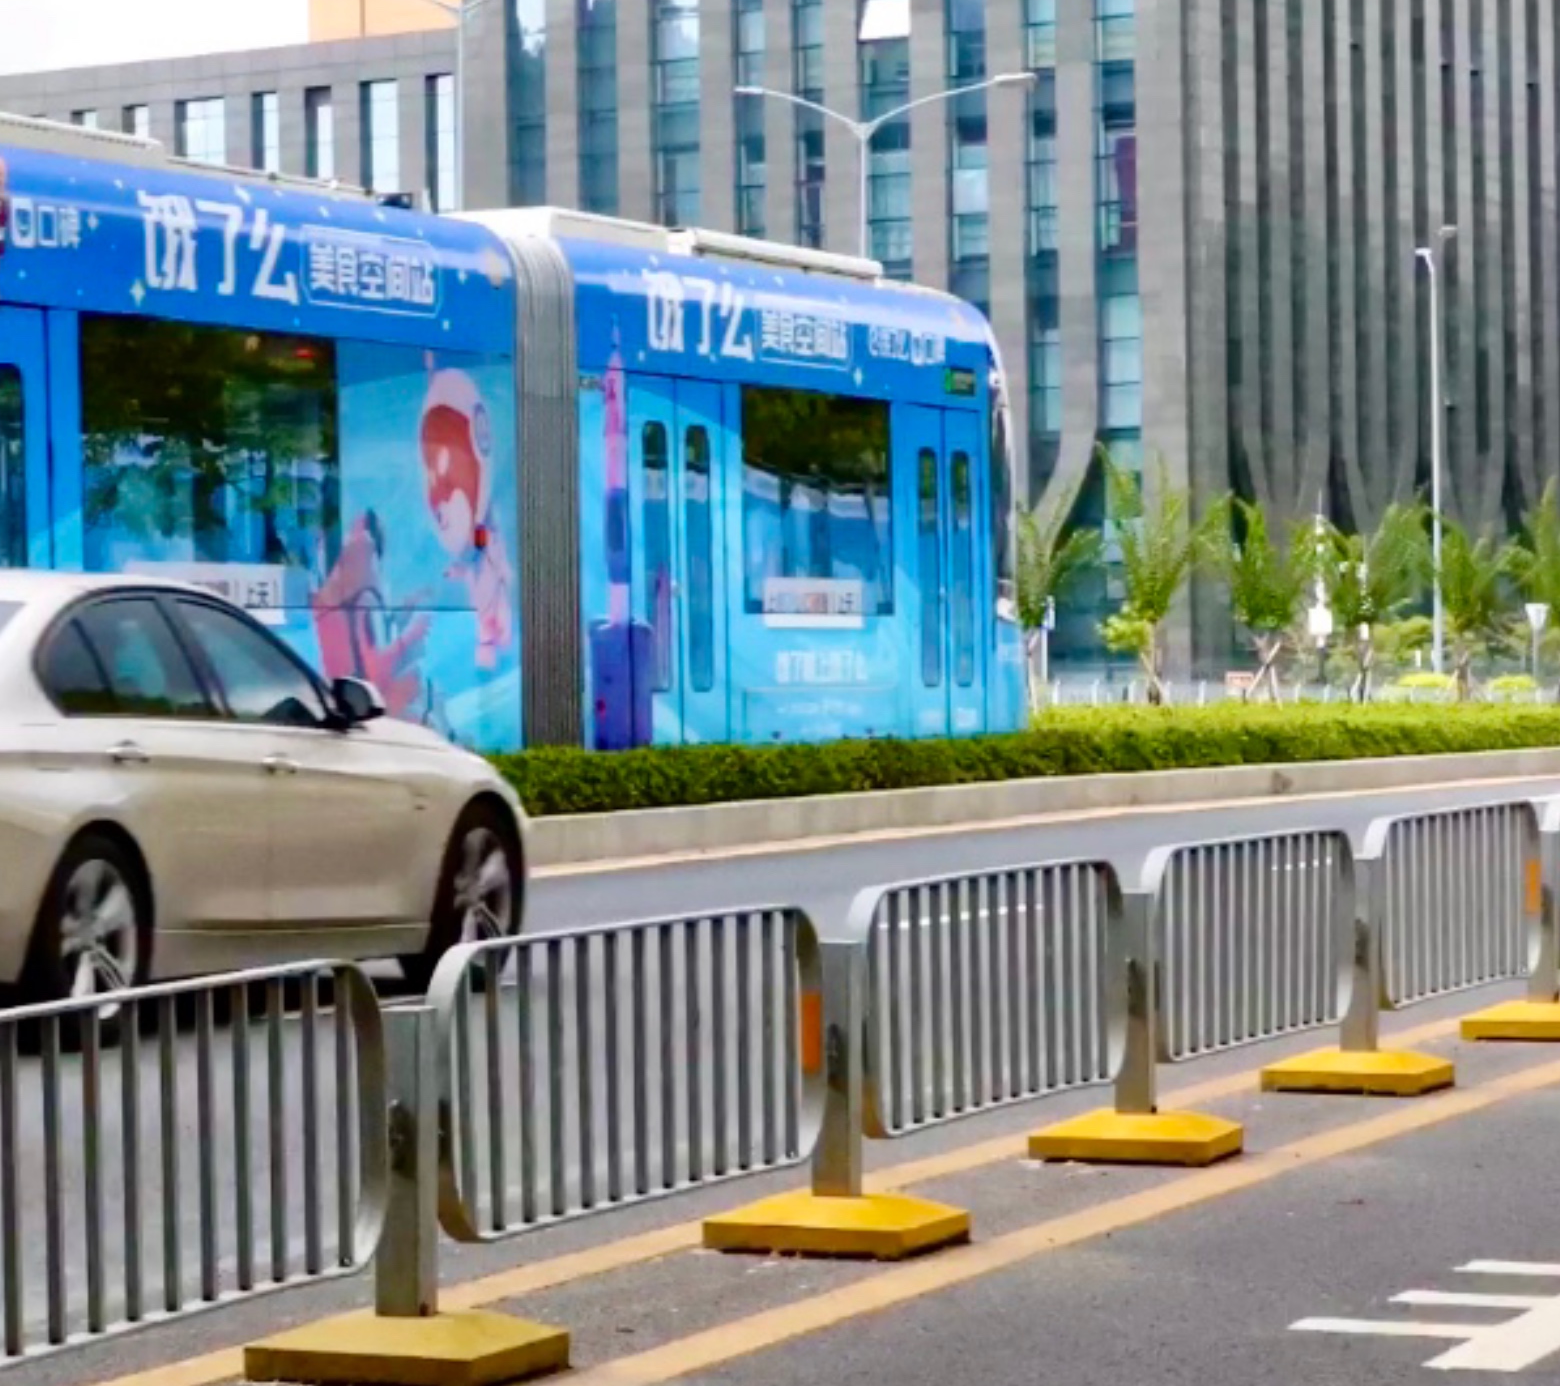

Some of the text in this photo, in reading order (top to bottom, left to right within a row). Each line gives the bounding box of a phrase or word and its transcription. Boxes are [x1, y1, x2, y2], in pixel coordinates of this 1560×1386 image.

[136, 187, 300, 305] 饿了么
[308, 239, 436, 305] 美食空间站
[641, 266, 755, 362] 饿了么
